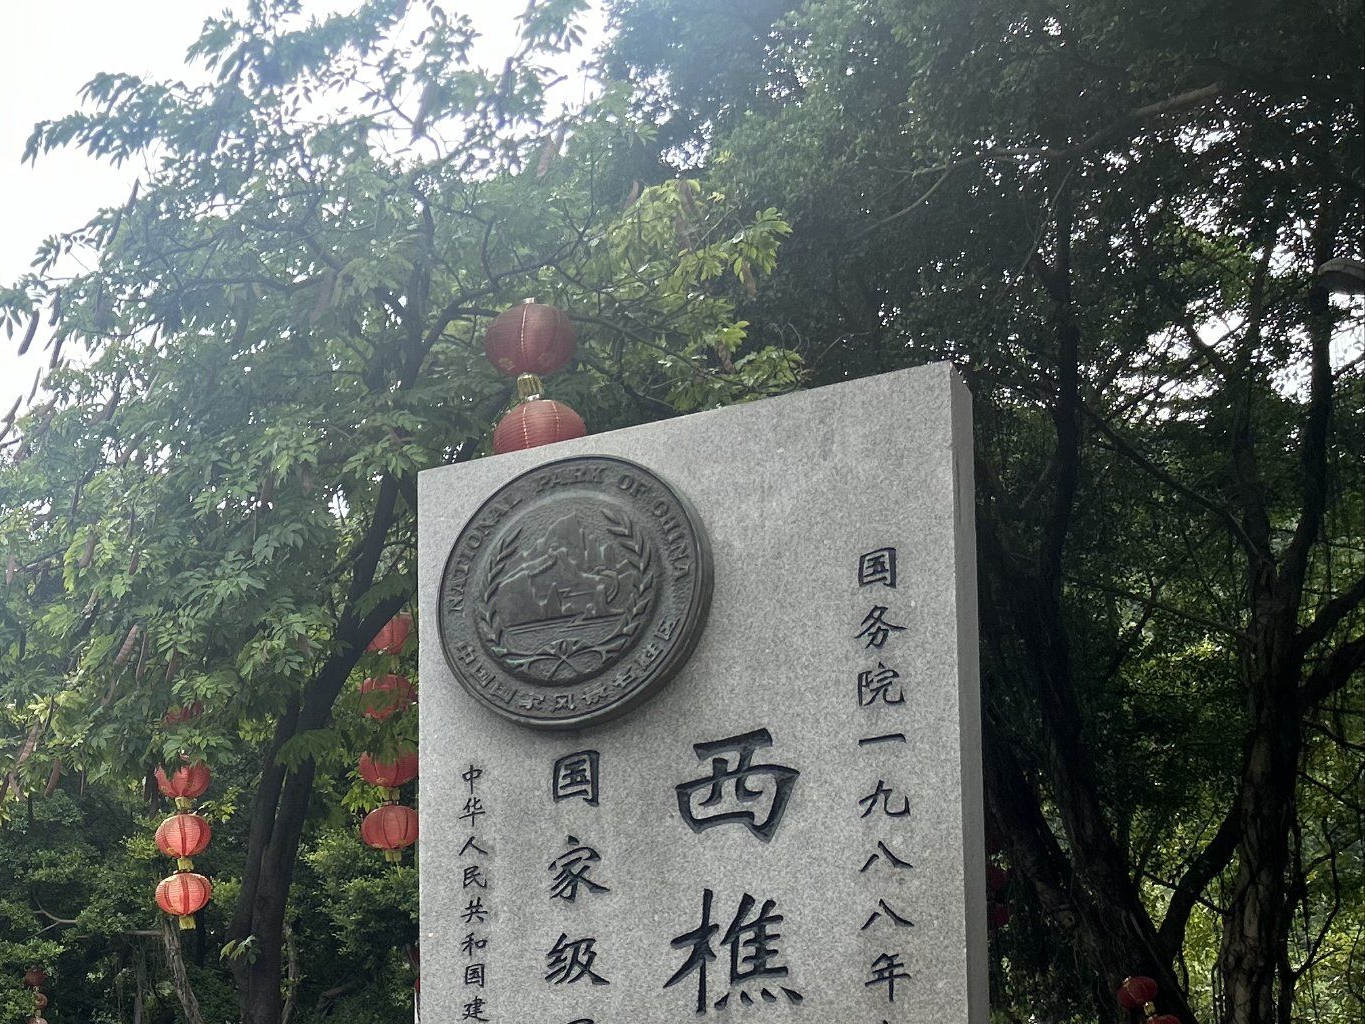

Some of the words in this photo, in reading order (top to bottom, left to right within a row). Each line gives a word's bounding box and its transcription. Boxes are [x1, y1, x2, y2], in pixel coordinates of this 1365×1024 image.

[448, 498, 523, 617] NATIONAL
[535, 465, 609, 495] PARK
[617, 473, 651, 500] OF
[651, 500, 691, 581] CHINA
